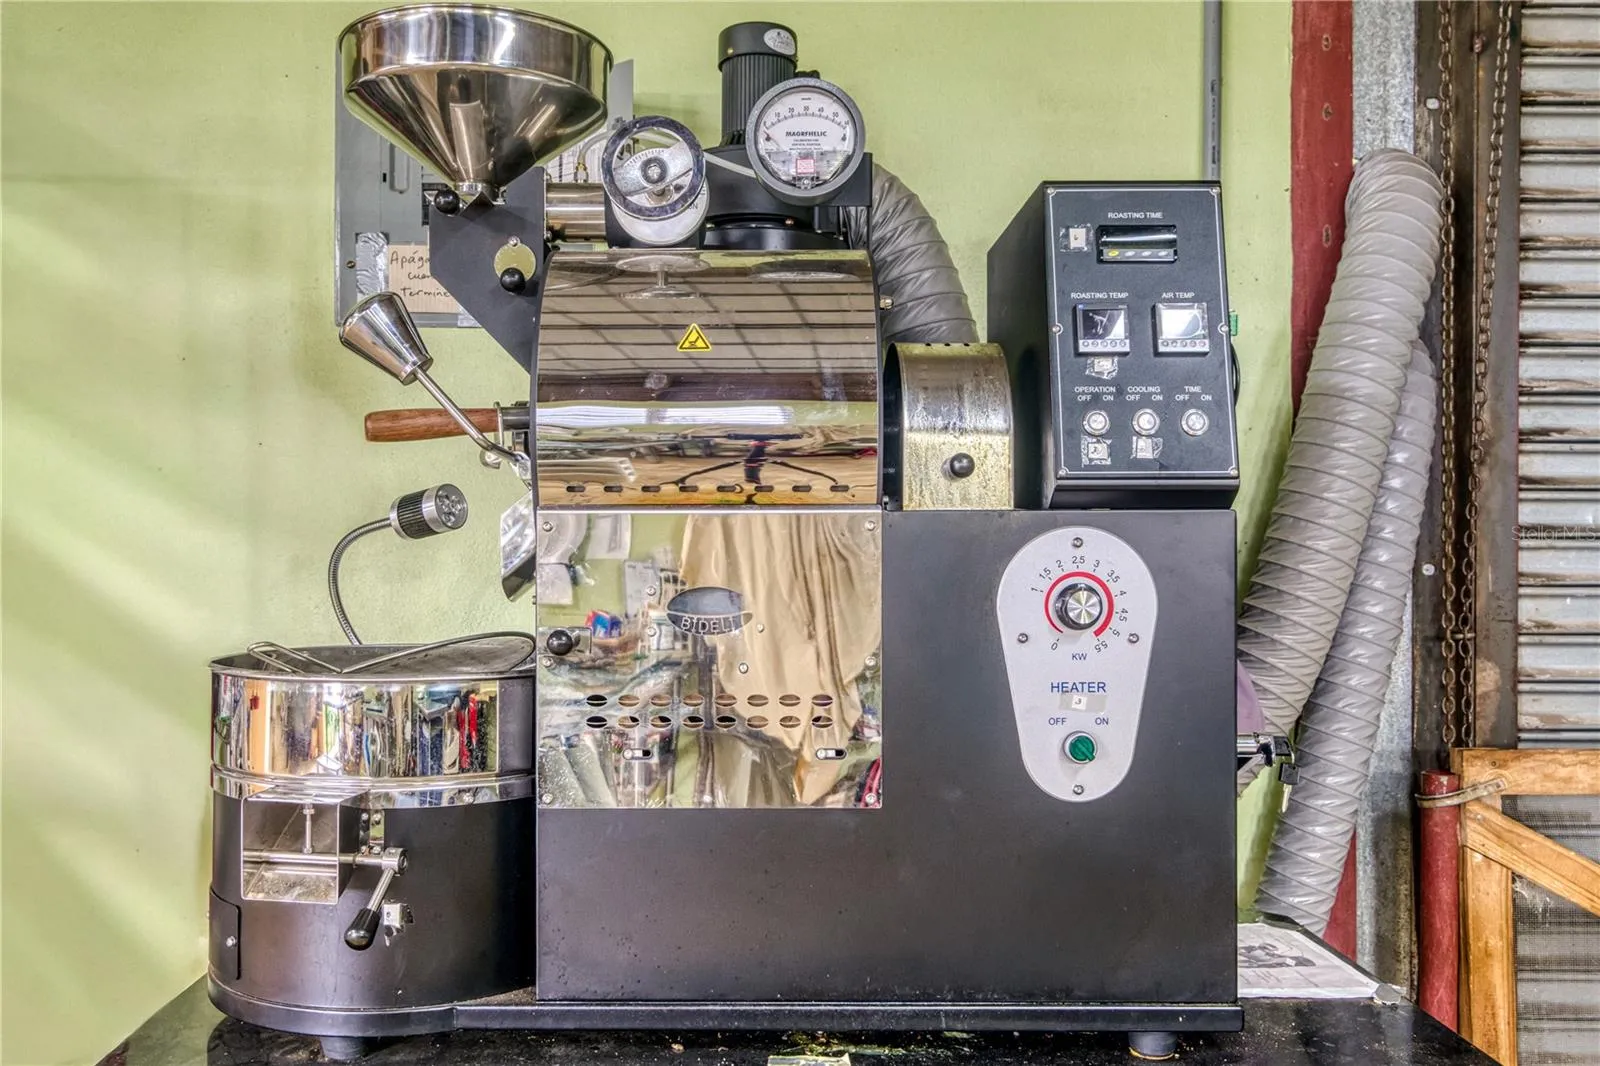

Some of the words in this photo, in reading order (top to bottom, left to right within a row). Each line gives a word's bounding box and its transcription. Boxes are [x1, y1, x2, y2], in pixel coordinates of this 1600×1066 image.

[1107, 211, 1144, 219] ROASTING
[1146, 211, 1163, 219] TIME
[1056, 559, 1063, 568] 2
[1093, 559, 1101, 568] 3
[1039, 567, 1051, 580] 1.5
[1112, 630, 1121, 638] 5
[1050, 642, 1058, 651] 0
[1071, 653, 1088, 661] KW
[1050, 681, 1107, 693] HEATER
[1048, 717, 1067, 726] OFF
[1094, 717, 1109, 726] ON
